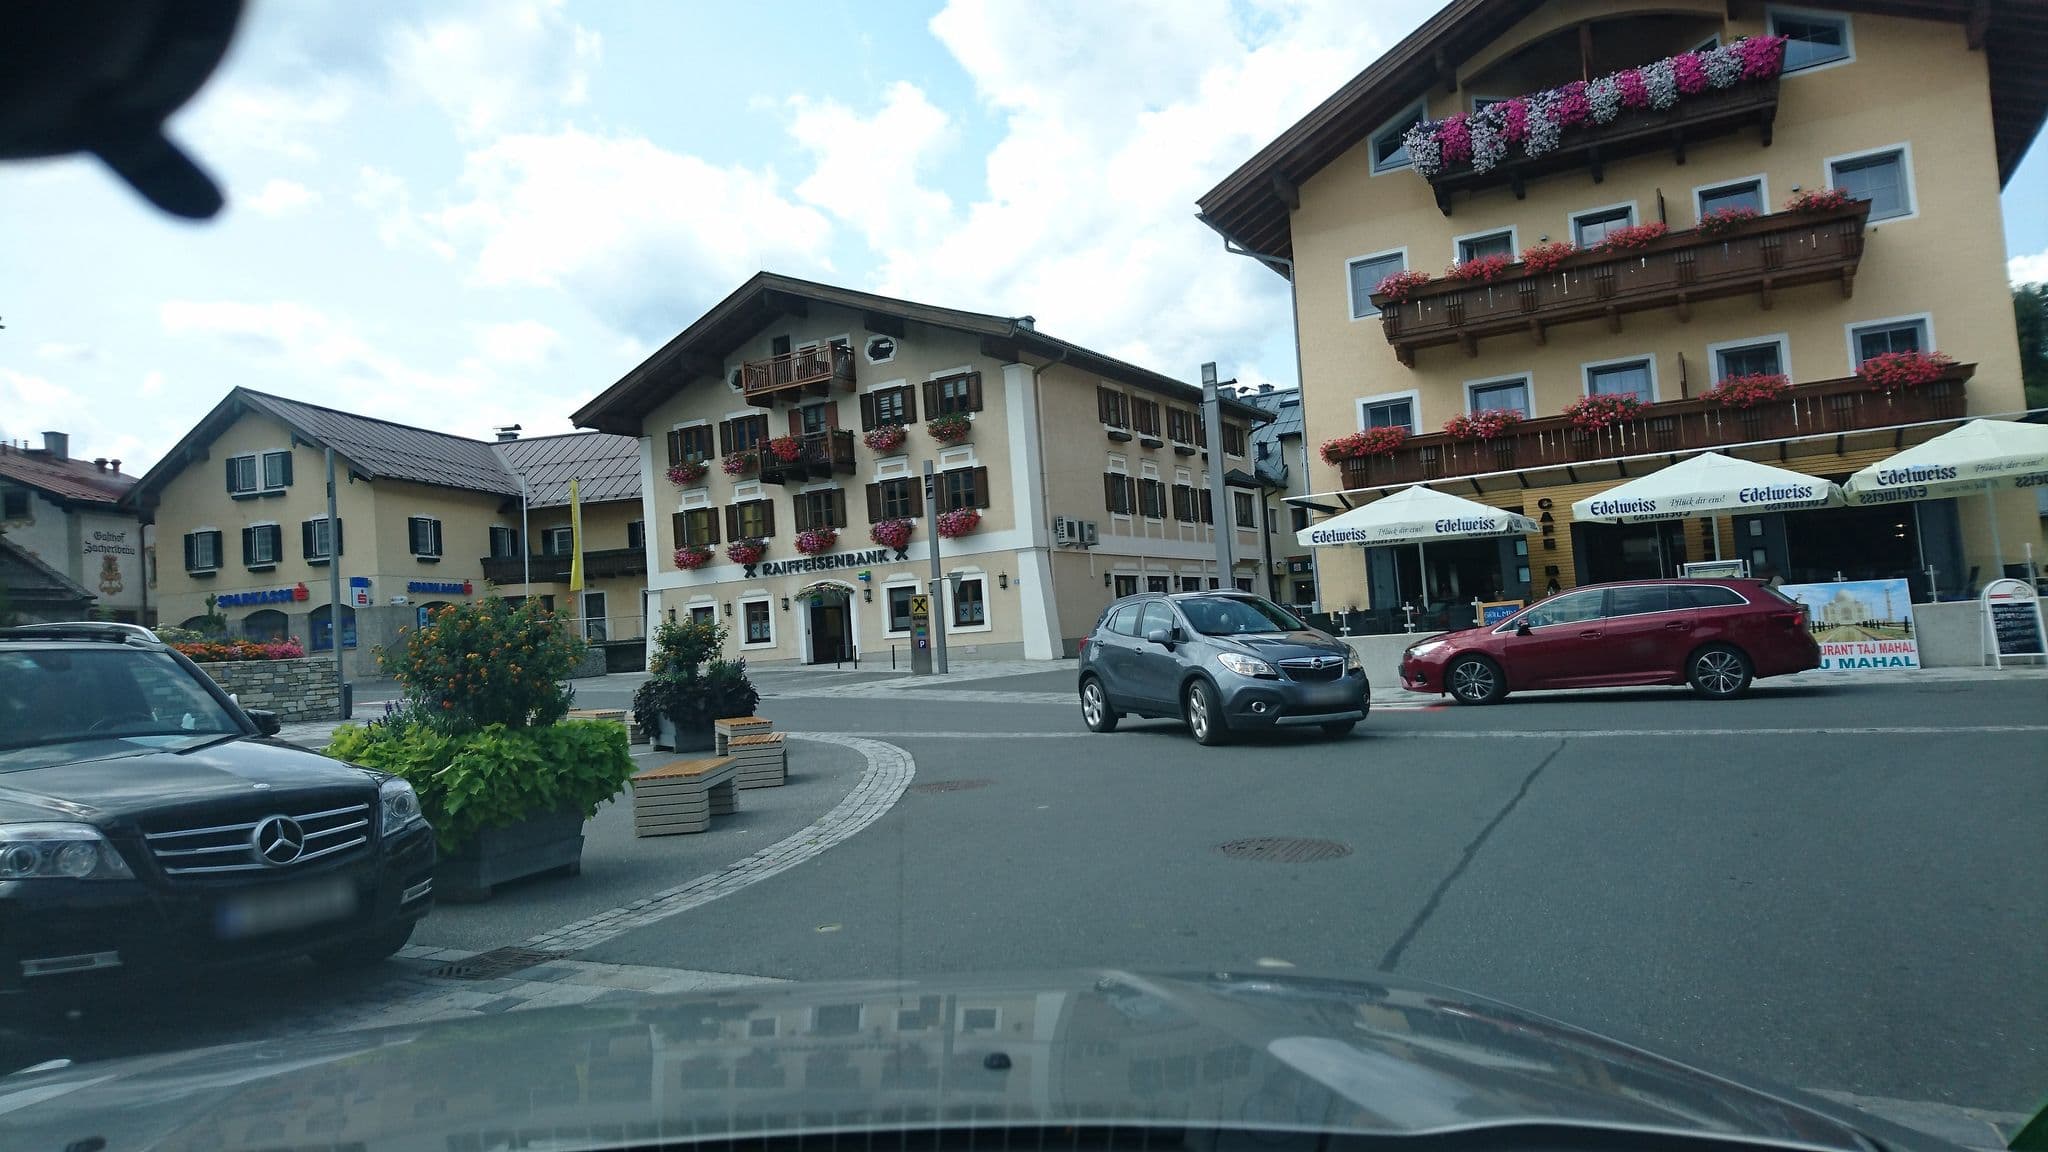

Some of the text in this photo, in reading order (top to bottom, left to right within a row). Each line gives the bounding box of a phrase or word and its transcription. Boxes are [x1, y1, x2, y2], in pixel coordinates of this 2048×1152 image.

[1876, 464, 1958, 487] Edelweiss
[1590, 498, 1657, 517] Edelweiss
[1738, 483, 1813, 504] Edelweiss
[1311, 527, 1367, 544] Edelweiss
[1435, 516, 1496, 534] Edelweiss
[762, 550, 890, 576] RAIFFEISENBANK
[217, 588, 294, 608] SPARKASSE
[1857, 643, 1876, 654] TAJ
[1879, 640, 1917, 653] MAHAL
[1838, 656, 1918, 669] MAHAL
